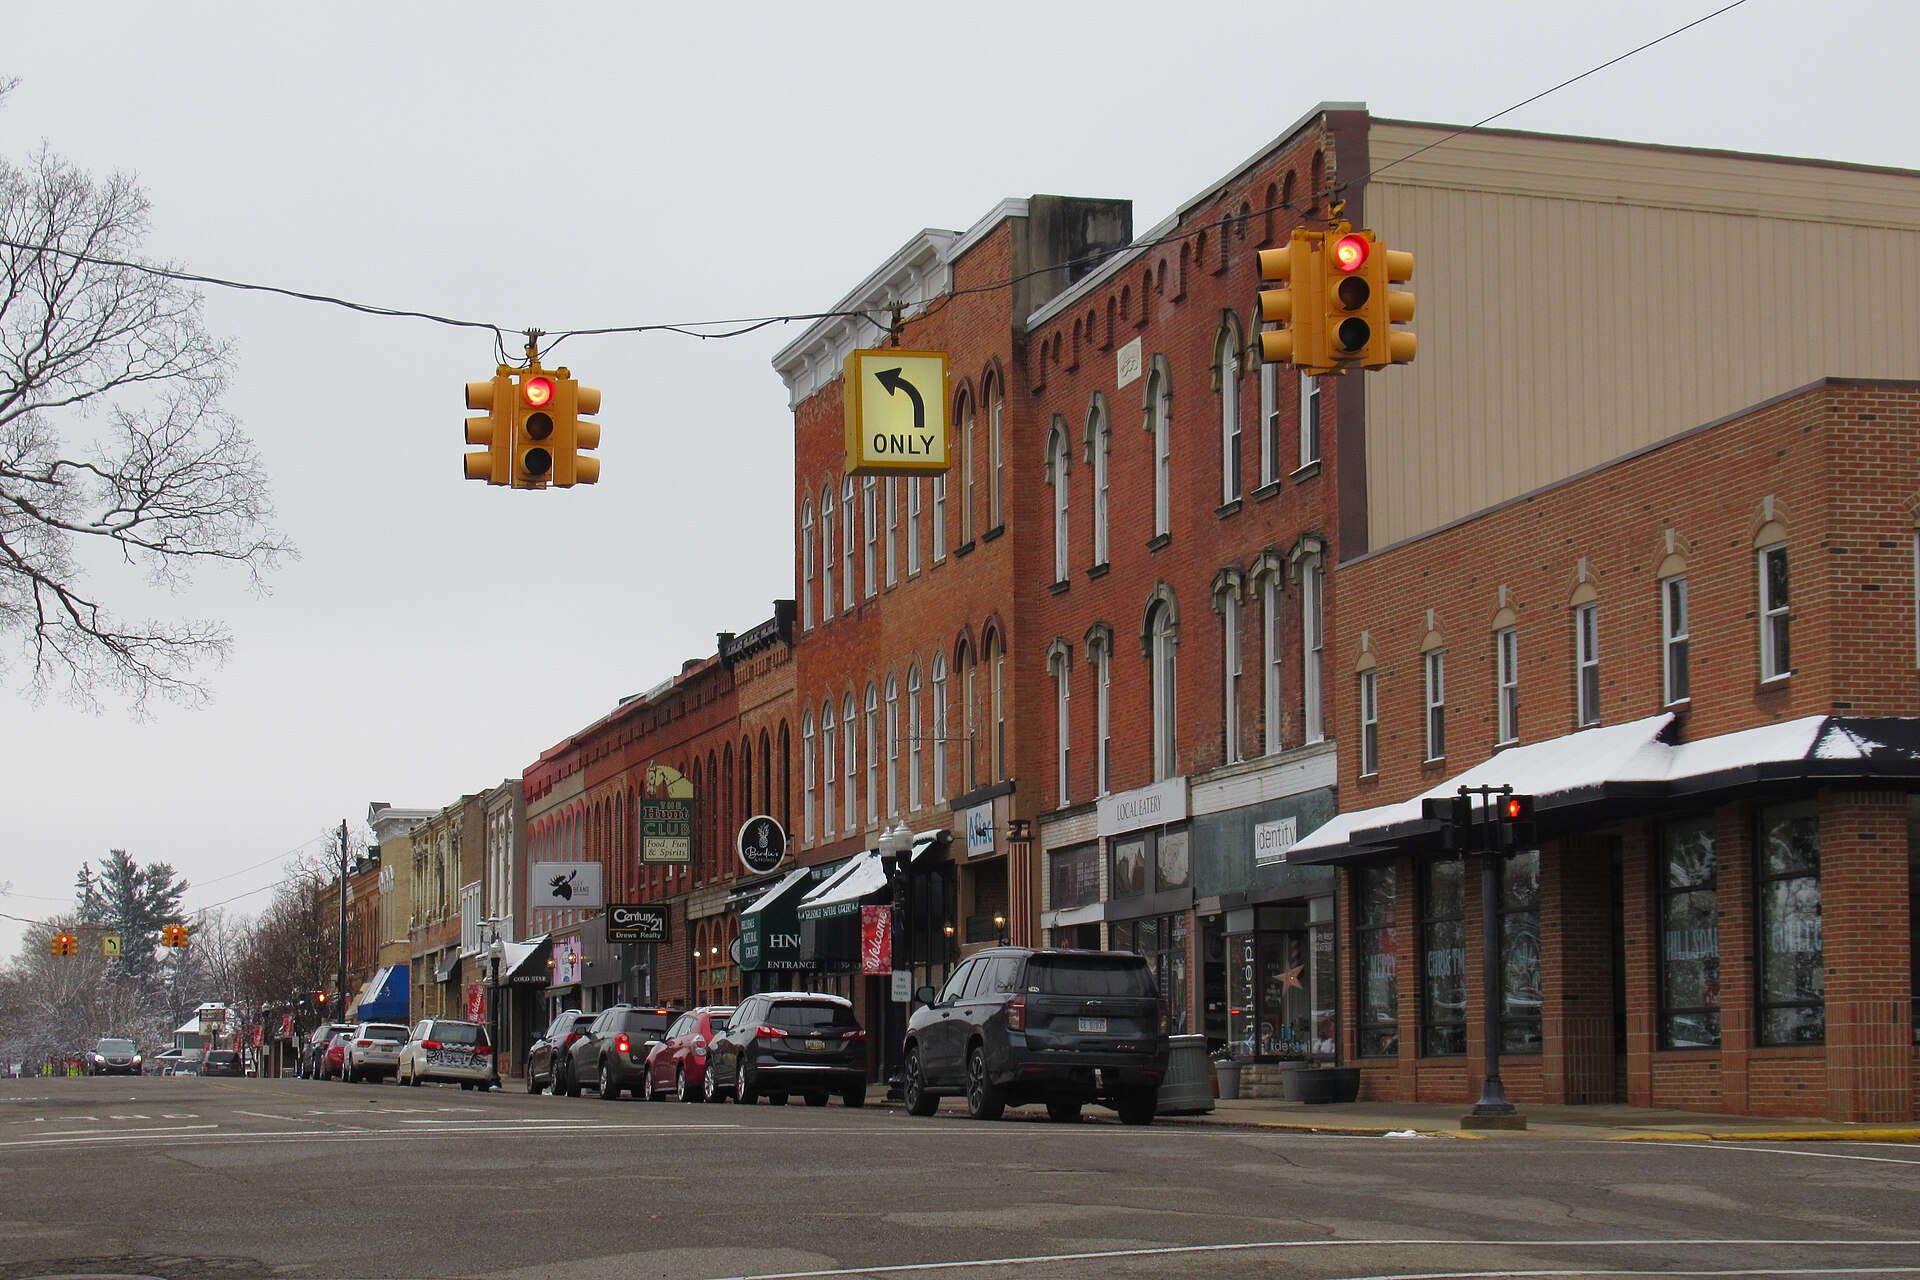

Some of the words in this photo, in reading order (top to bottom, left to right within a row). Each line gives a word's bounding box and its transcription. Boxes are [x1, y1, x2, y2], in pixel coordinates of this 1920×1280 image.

[874, 434, 935, 454] ONLY
[660, 801, 682, 810] THE
[1117, 801, 1138, 821] LOCAL
[1139, 795, 1162, 815] EATERY
[643, 806, 690, 820] Hunt
[643, 823, 690, 836] CLUB
[1256, 821, 1296, 849] identity
[647, 839, 669, 849] Food,
[672, 840, 687, 848] Fun
[659, 849, 686, 858] Spirits
[745, 846, 779, 859] Birdie's
[614, 909, 655, 924] Century
[650, 918, 663, 931] 21
[640, 932, 661, 940] Realty
[769, 934, 801, 948] HN
[865, 911, 888, 969] Welcome
[767, 960, 817, 969] ENTRANCE
[1244, 938, 1255, 1051] identity
[470, 986, 484, 1021] Welcome
